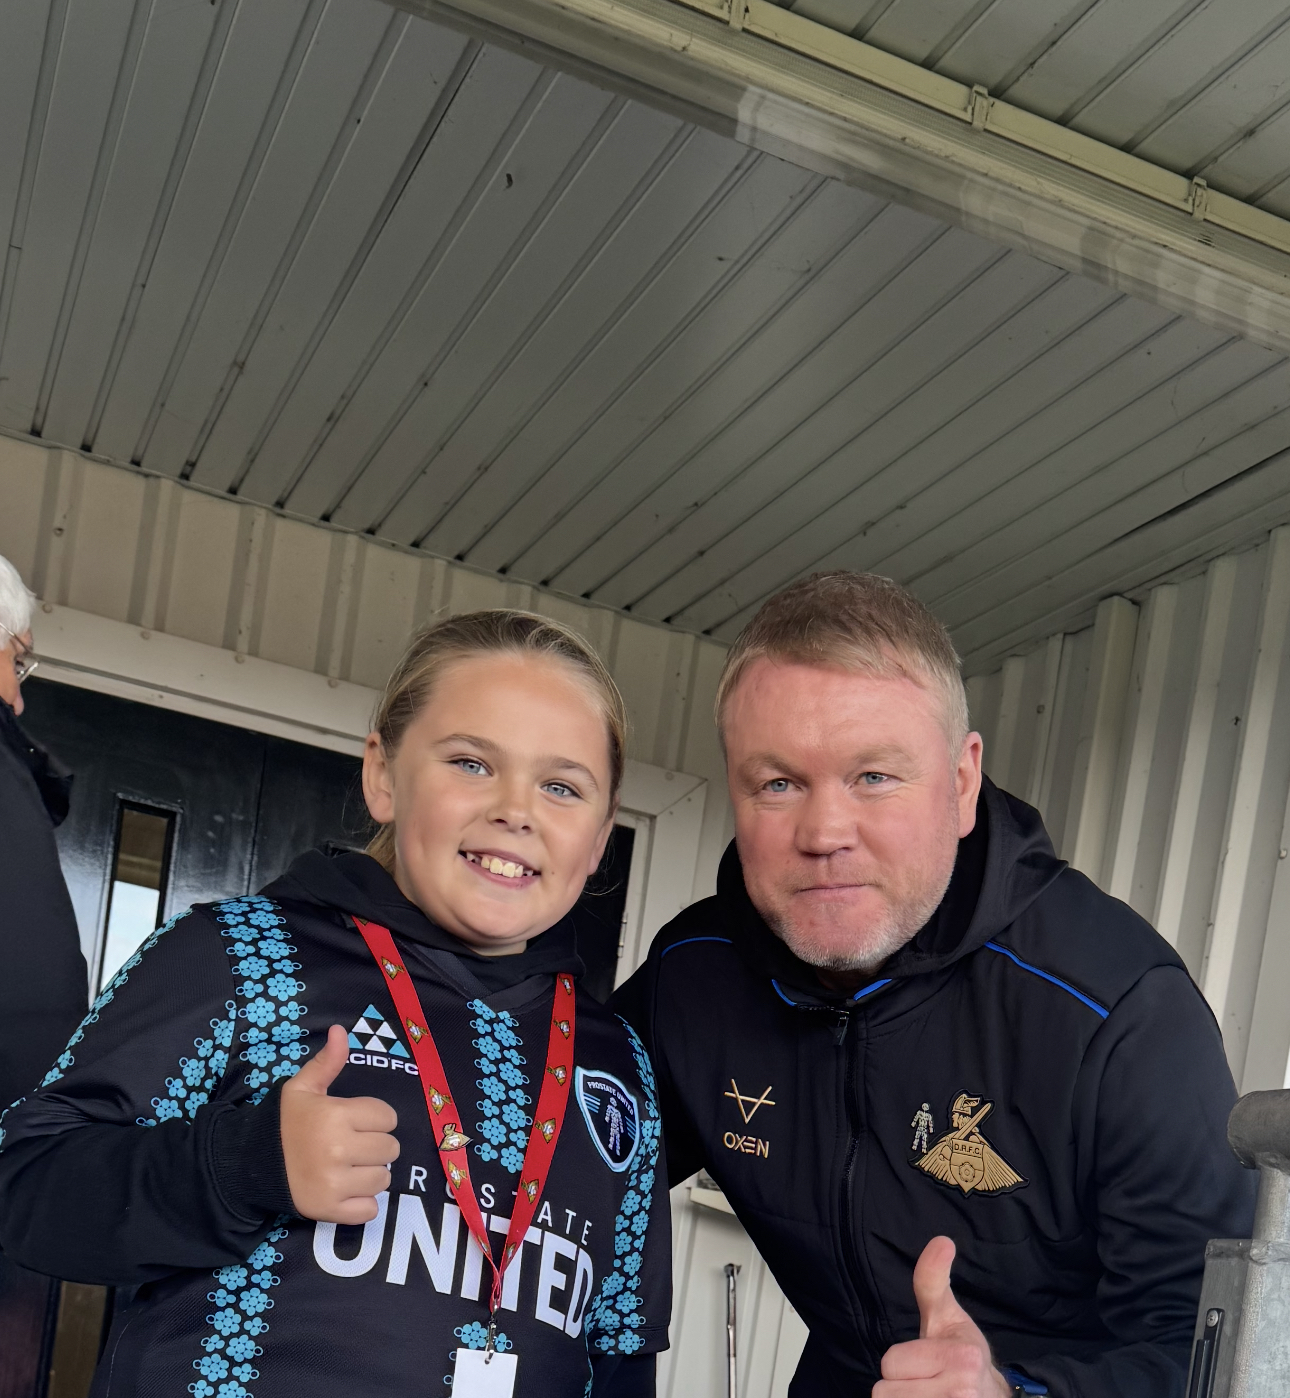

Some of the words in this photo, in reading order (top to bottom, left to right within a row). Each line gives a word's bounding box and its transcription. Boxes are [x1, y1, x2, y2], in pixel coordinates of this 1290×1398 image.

[346, 1053, 389, 1068] CID
[723, 1131, 770, 1159] OXEN
[385, 1162, 593, 1246] RSATE
[313, 1190, 594, 1339] UNITED
